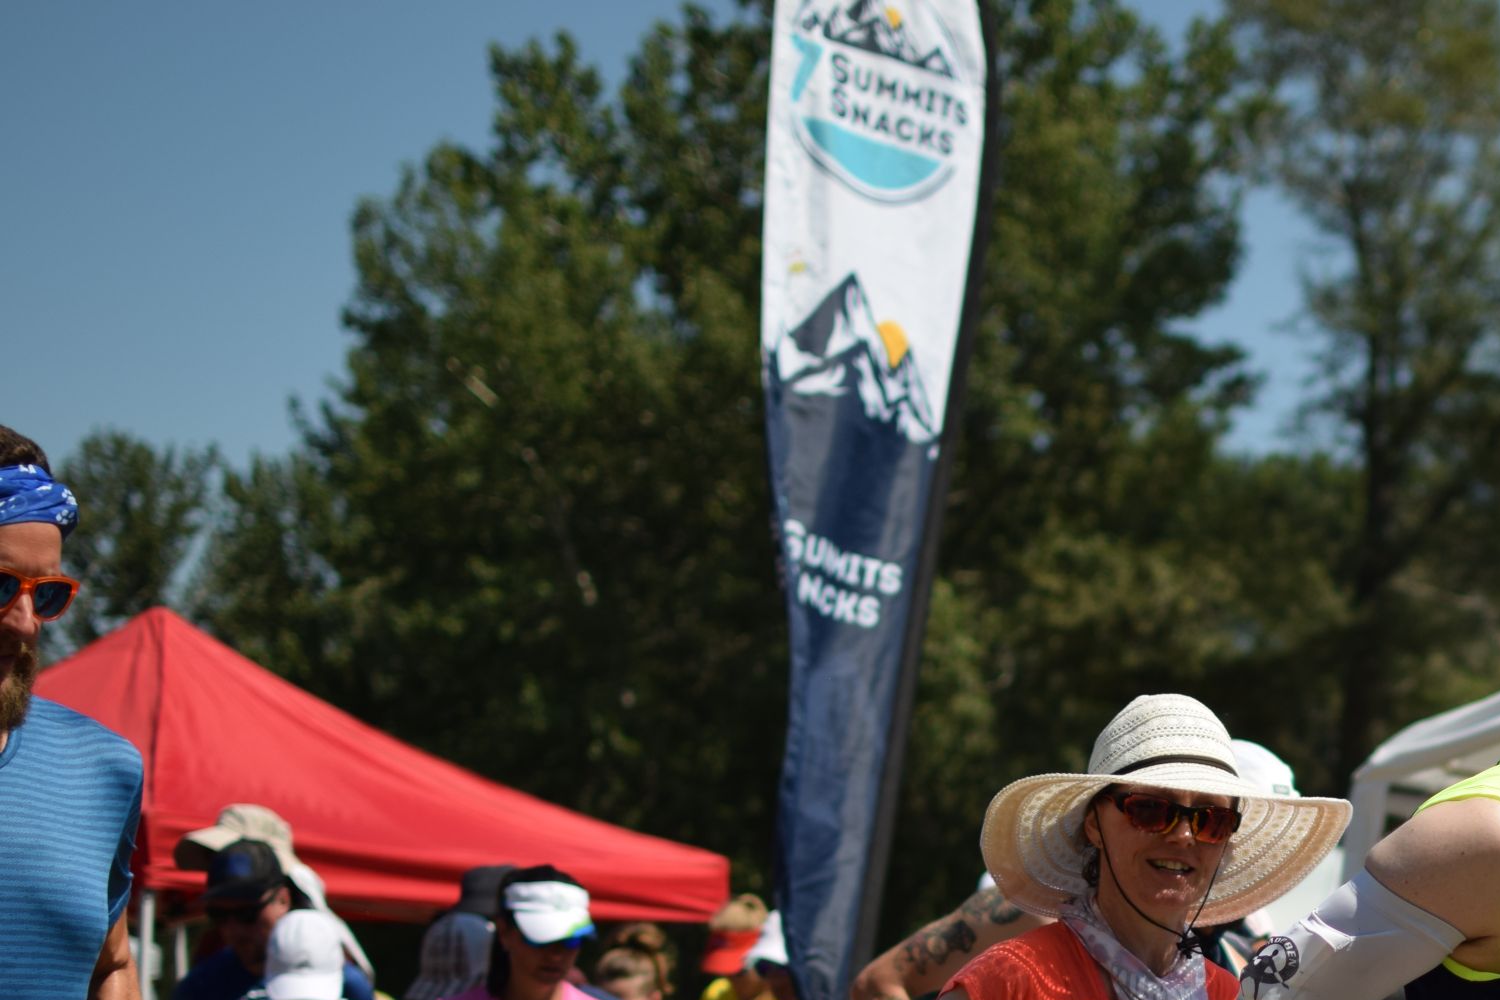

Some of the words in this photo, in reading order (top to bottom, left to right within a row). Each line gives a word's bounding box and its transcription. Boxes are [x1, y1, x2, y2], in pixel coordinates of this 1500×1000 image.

[790, 33, 823, 103] 7
[829, 52, 968, 127] SUMMITS
[829, 86, 954, 155] SNACKS
